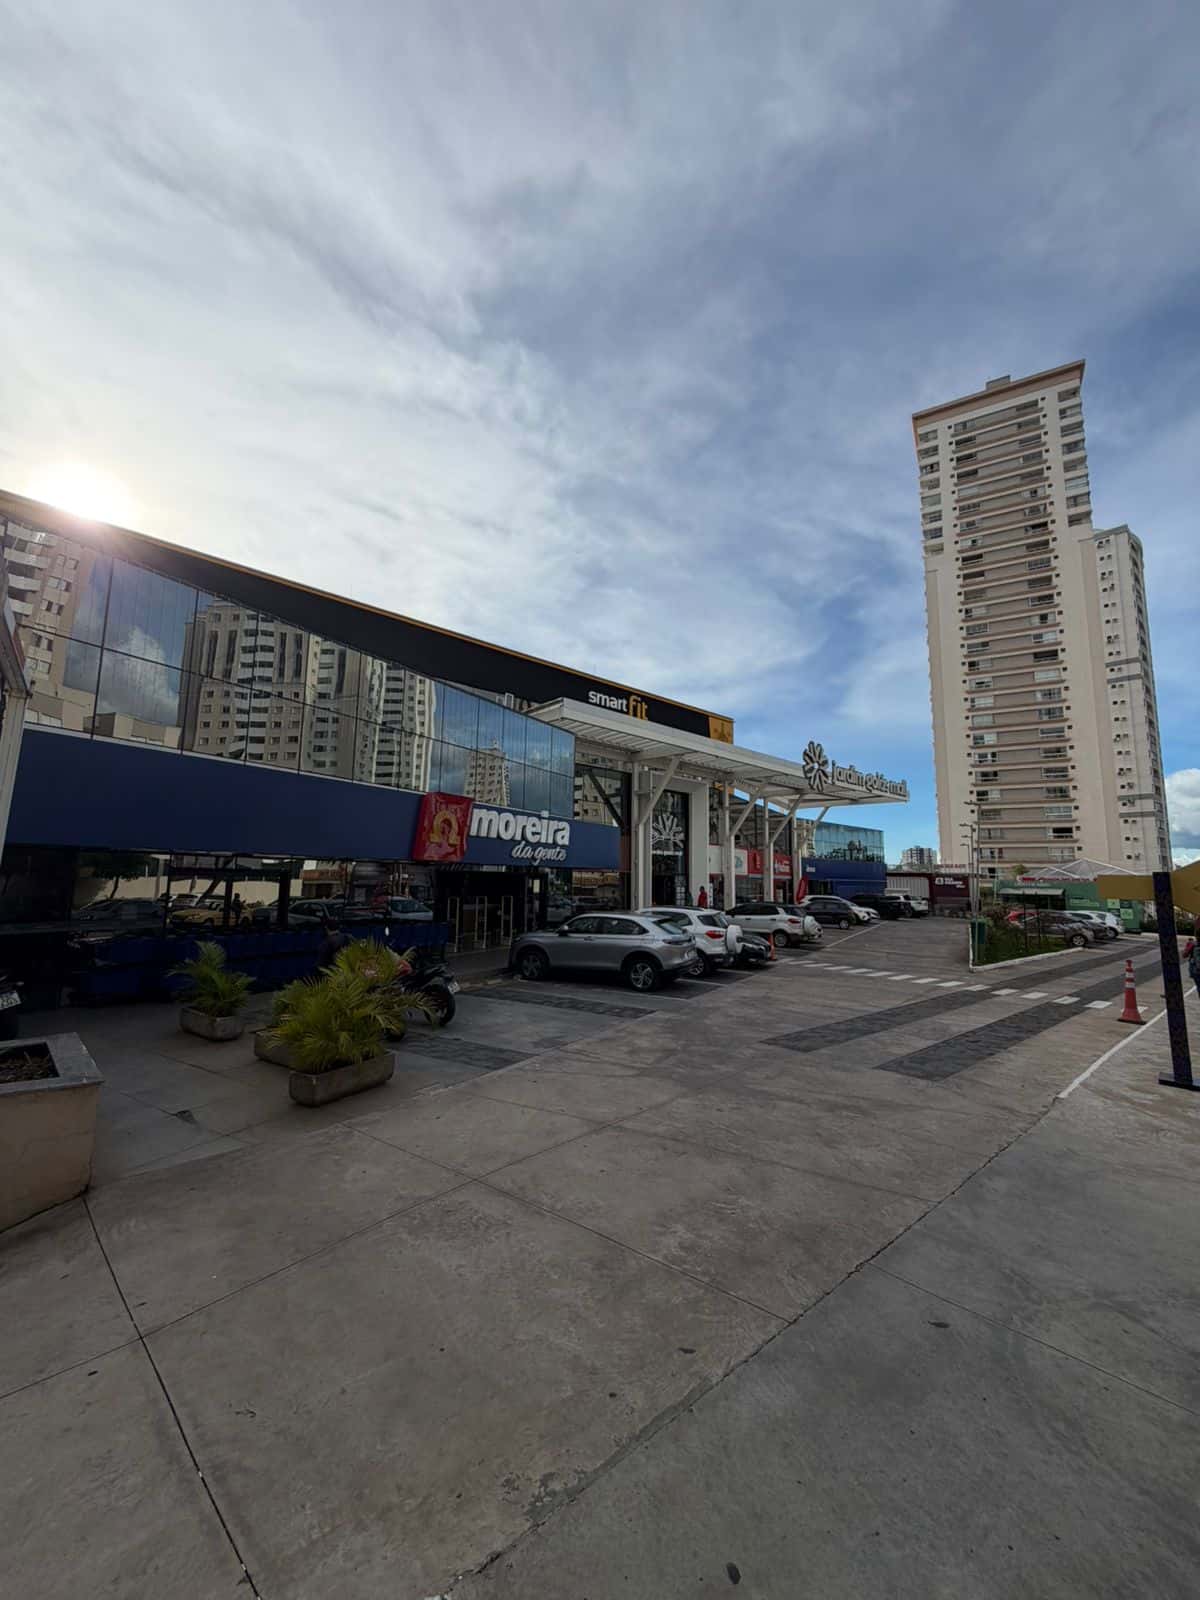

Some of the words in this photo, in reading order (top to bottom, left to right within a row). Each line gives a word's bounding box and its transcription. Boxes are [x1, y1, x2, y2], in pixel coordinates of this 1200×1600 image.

[588, 691, 628, 712] smart
[629, 695, 648, 720] fit
[832, 760, 864, 786] jardim
[470, 808, 570, 845] moreira
[511, 840, 532, 858] da
[531, 847, 566, 865] gente
